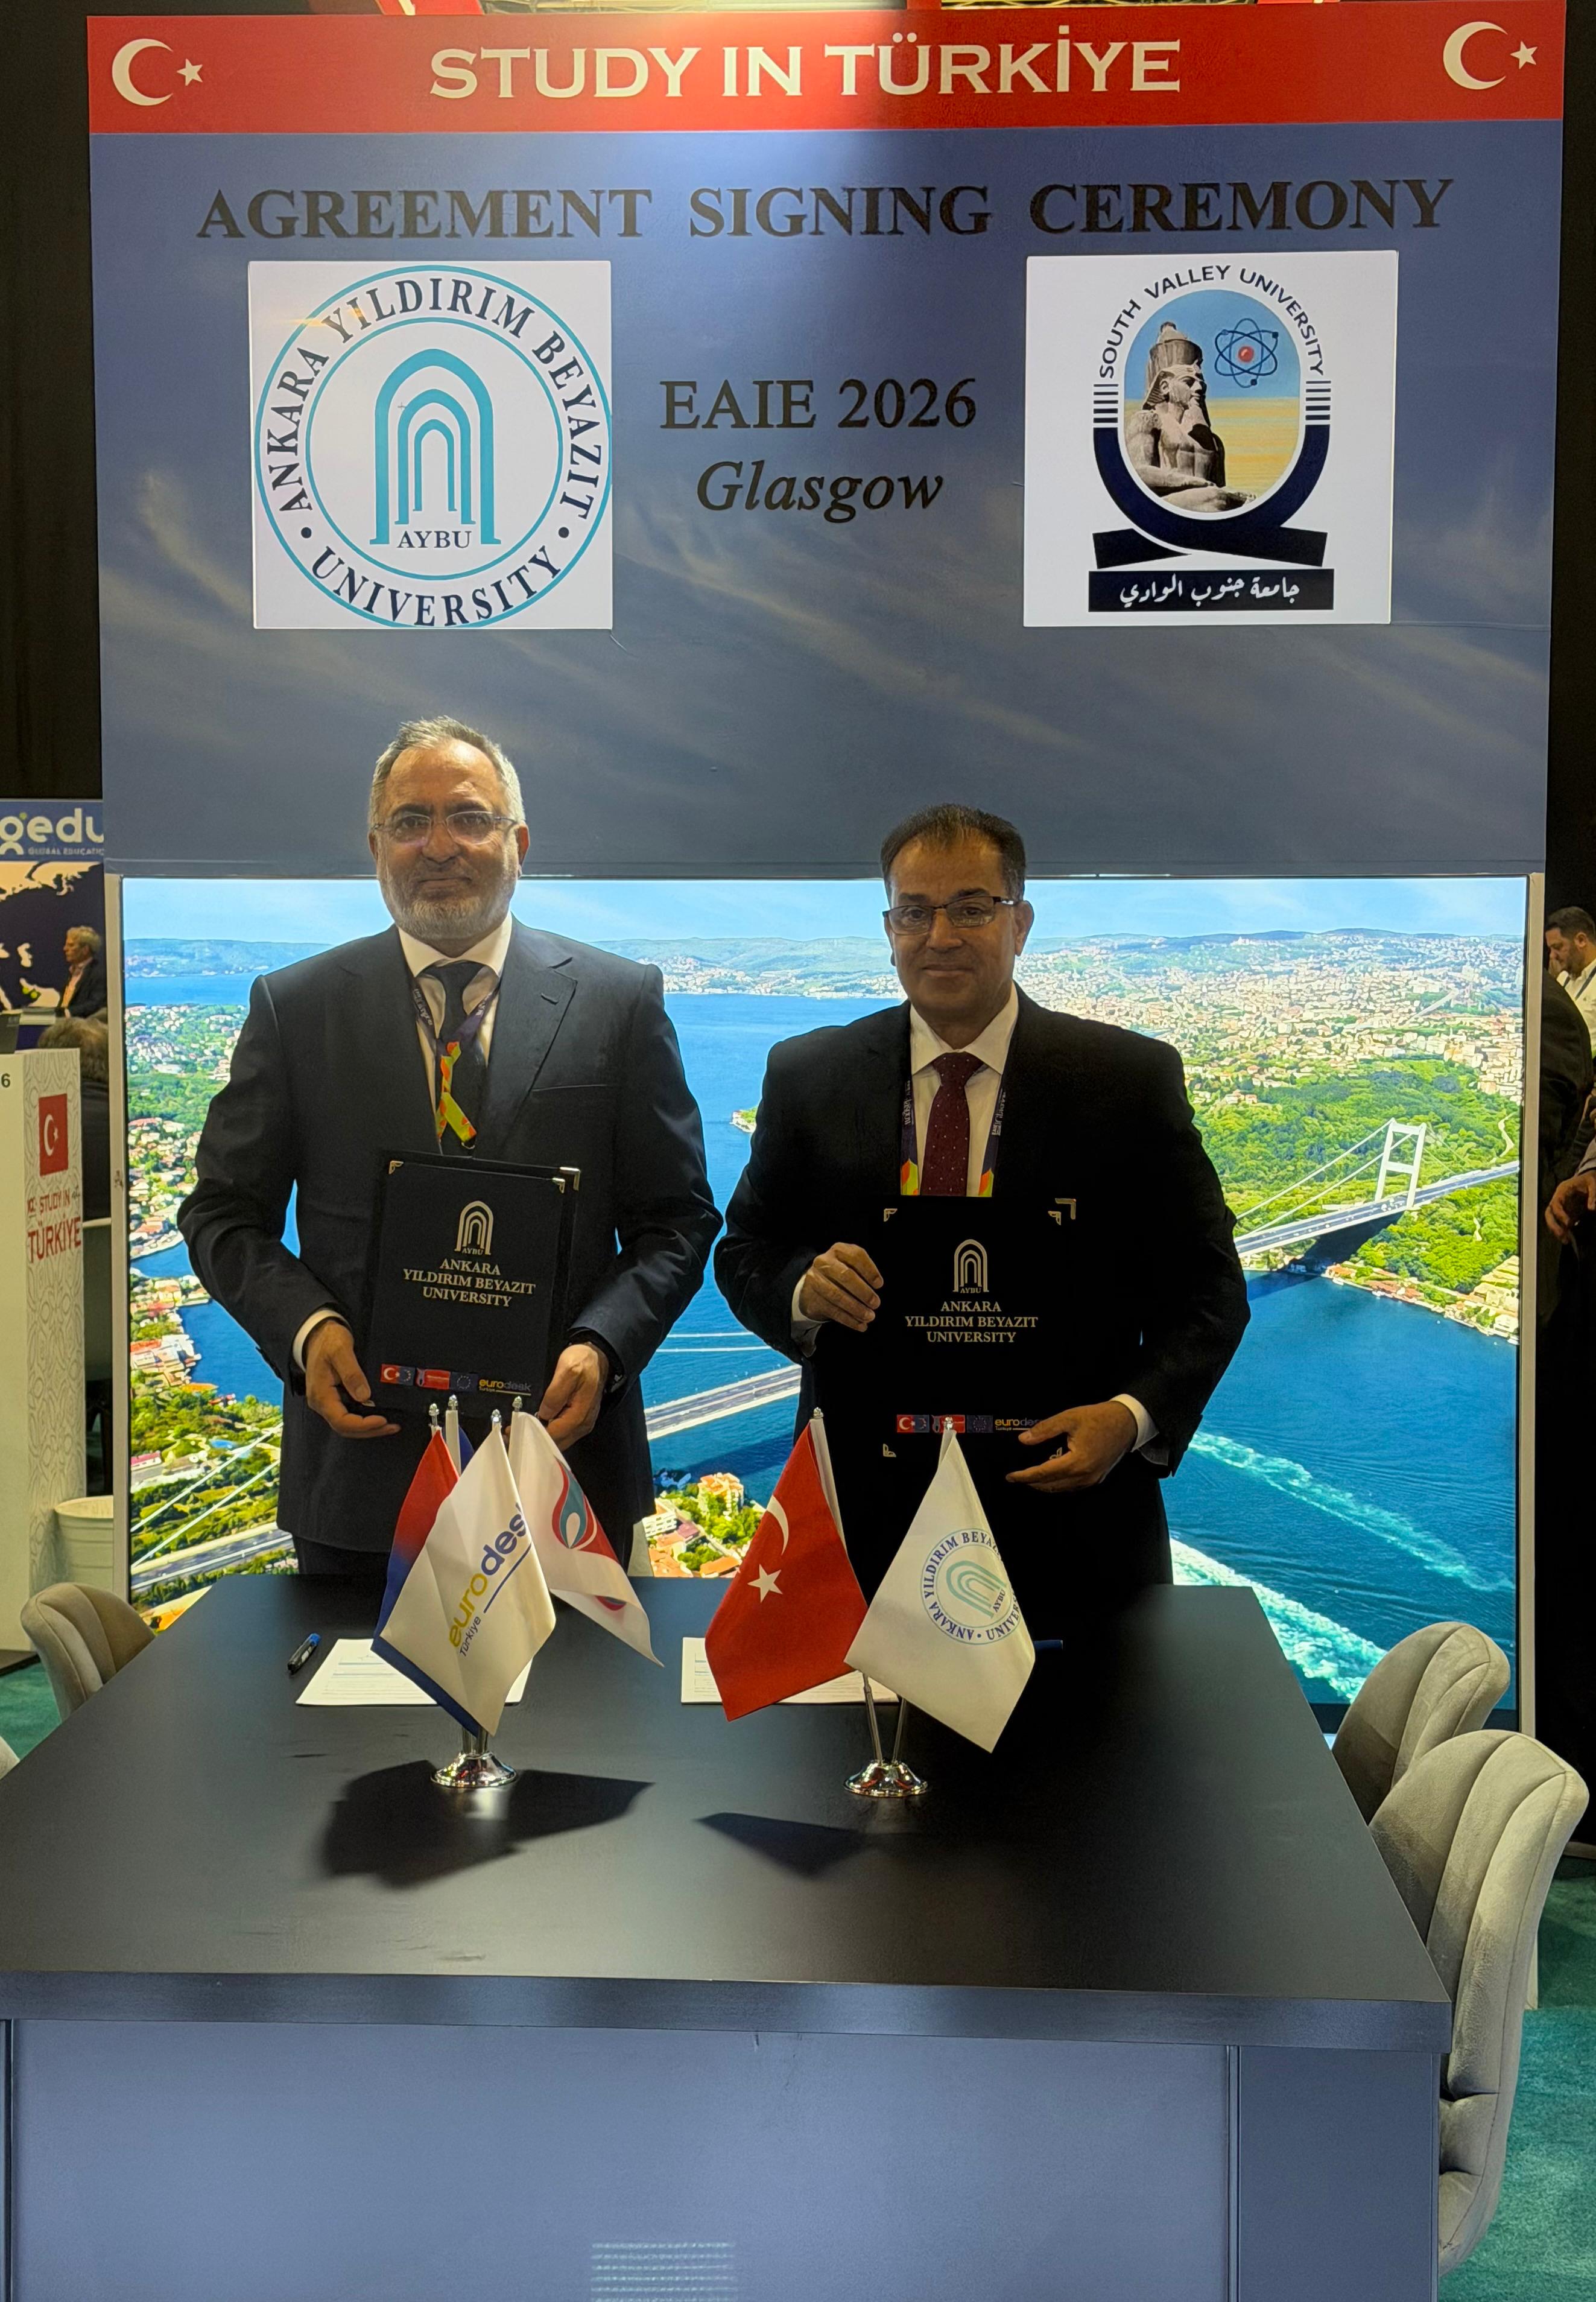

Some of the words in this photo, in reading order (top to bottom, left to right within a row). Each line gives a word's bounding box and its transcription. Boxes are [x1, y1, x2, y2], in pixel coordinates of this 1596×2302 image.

[430, 46, 702, 99] STUDY
[721, 46, 802, 97] IN
[824, 25, 1181, 97] TÜRKİYE
[196, 188, 652, 239] AGREEMENT
[689, 184, 992, 238] SIGNING
[1029, 178, 1454, 234] CEREMONY
[1099, 299, 1141, 379] SOUTH
[1144, 264, 1232, 299] VALLEY
[1240, 268, 1324, 376] UNIVERSITY
[267, 347, 329, 512] ANKARA
[321, 277, 534, 343] YILDIRIM
[532, 331, 602, 520] BEYAZIT
[660, 379, 817, 429] EAIE
[838, 378, 977, 428] 2026
[697, 460, 944, 524] Glasgow
[397, 530, 472, 548] AYBU
[311, 545, 561, 626] UNIVERSITY
[1119, 573, 1182, 608] الوادي
[1191, 577, 1244, 607] جنوب
[1250, 577, 1300, 604] جامعة
[1, 1073, 10, 1088] 6
[28, 1213, 81, 1264] TÜRKİYE
[403, 1268, 472, 1287] YILDIRIM
[475, 1276, 536, 1295] BEYAZIT
[439, 1258, 501, 1276] ANKARA
[423, 1286, 512, 1307] UNIVERSITY
[940, 1301, 1002, 1312] ANKARA
[905, 1316, 974, 1327] YILDIRIM
[977, 1316, 1039, 1328] BEYAZIT
[926, 1331, 1017, 1343] UNIVERSITY
[995, 1417, 1040, 1427] eurode
[961, 1531, 999, 1556] BEYA
[449, 1502, 527, 1647] eurodes
[923, 1536, 959, 1599] YILDIRIM
[460, 1616, 482, 1657] Türkiye
[929, 1601, 975, 1640] ANKARA
